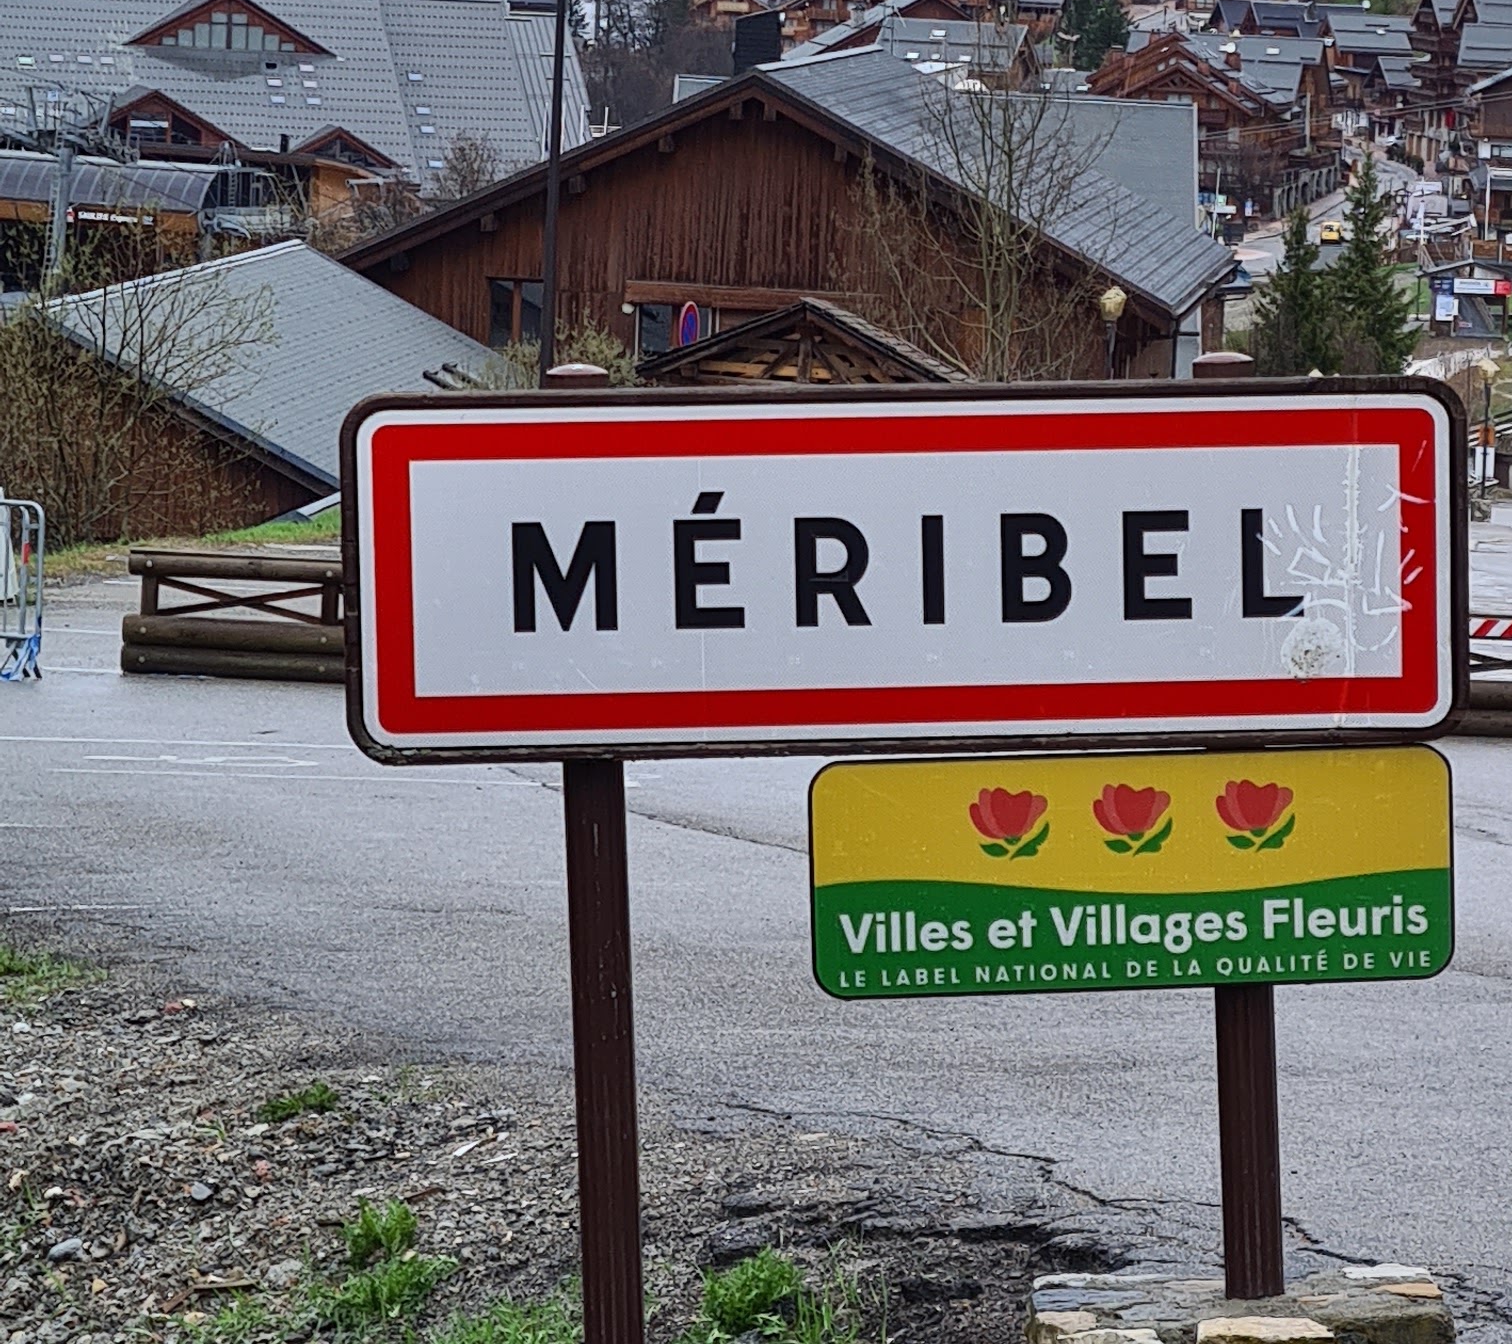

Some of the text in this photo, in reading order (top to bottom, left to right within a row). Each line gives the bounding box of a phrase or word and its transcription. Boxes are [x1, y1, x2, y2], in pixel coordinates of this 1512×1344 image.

[511, 491, 1305, 633] MÉRIBEL
[839, 895, 1429, 954] Villes et Villages Fleuris
[840, 949, 1431, 988] LE LABEL NATIONAL DE LA QUALITÉ DE VIE
